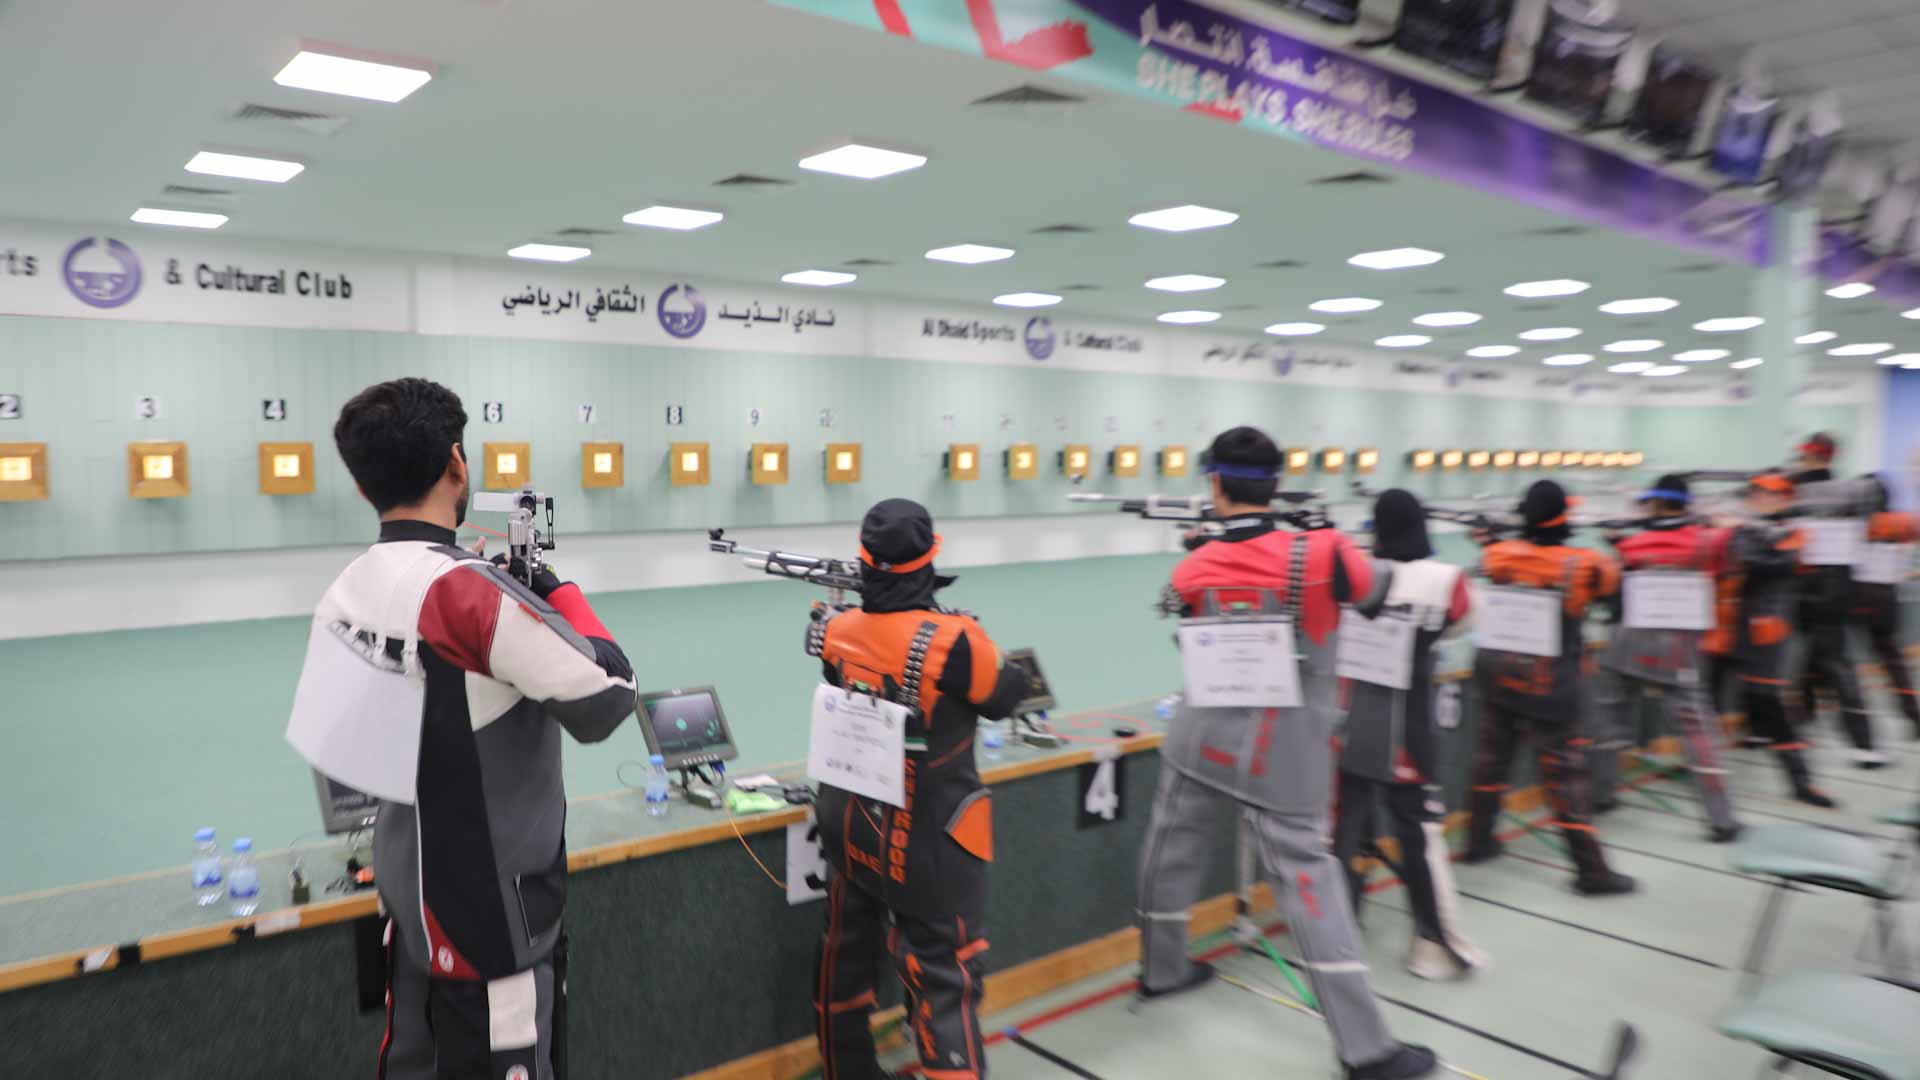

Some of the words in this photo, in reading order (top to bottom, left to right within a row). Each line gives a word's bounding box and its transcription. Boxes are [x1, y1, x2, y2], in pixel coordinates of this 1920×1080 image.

[1137, 51, 1199, 100] SHE
[165, 257, 182, 285] &
[197, 263, 286, 295] Cultural
[297, 270, 353, 299] Club
[502, 284, 581, 318] الرياضي
[585, 284, 646, 323] الثقافي
[793, 307, 836, 334] نادي
[972, 321, 1016, 344] Sports
[0, 395, 20, 419] 2
[141, 397, 156, 419] 3
[265, 399, 284, 420] 4
[486, 402, 501, 423] 6
[582, 404, 593, 424] 7
[668, 405, 681, 425] 8
[750, 407, 760, 428] 9
[1085, 760, 1119, 821] 4
